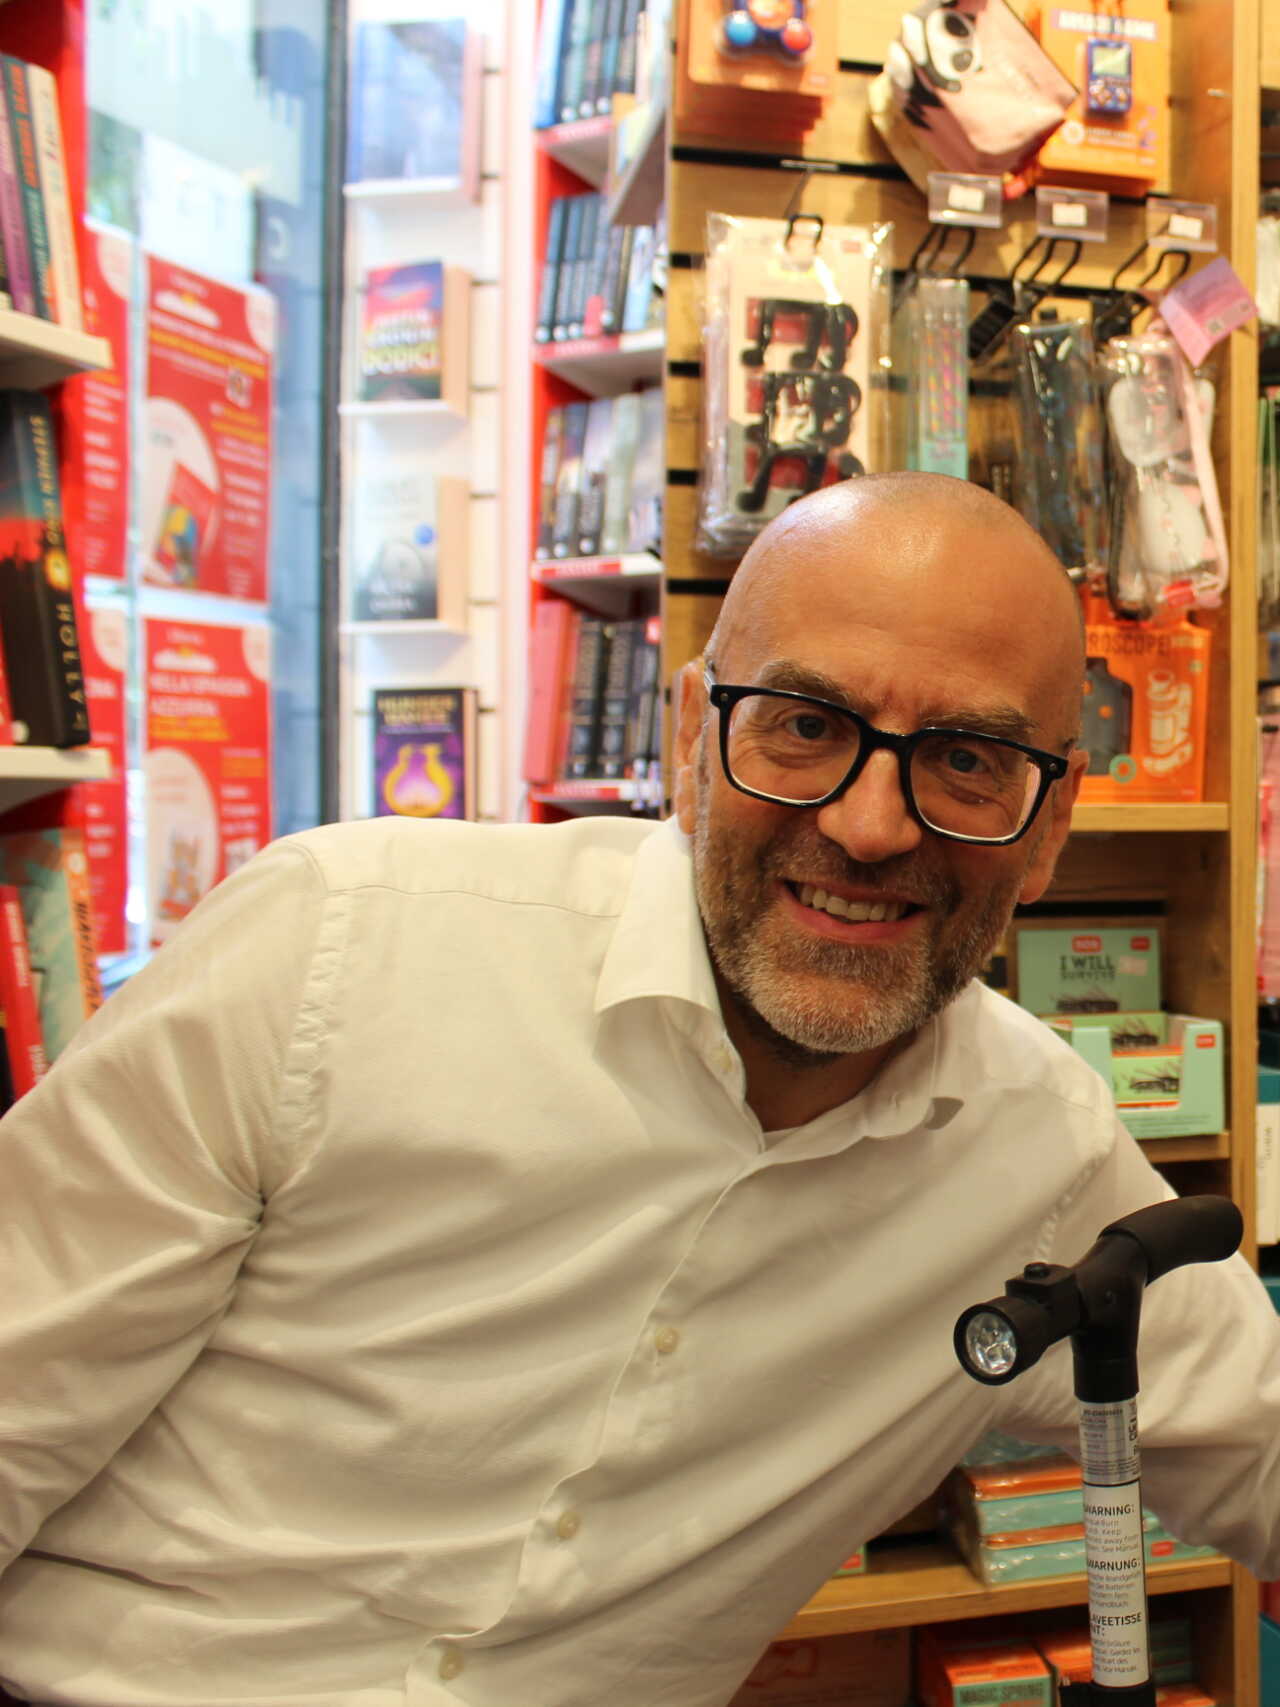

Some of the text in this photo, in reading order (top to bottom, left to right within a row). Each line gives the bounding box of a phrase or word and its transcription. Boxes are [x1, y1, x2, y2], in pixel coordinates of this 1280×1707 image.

[56, 602, 86, 706] HOLLY
[1073, 954, 1115, 970] WILL
[1001, 1682, 1045, 1700] SPRING
